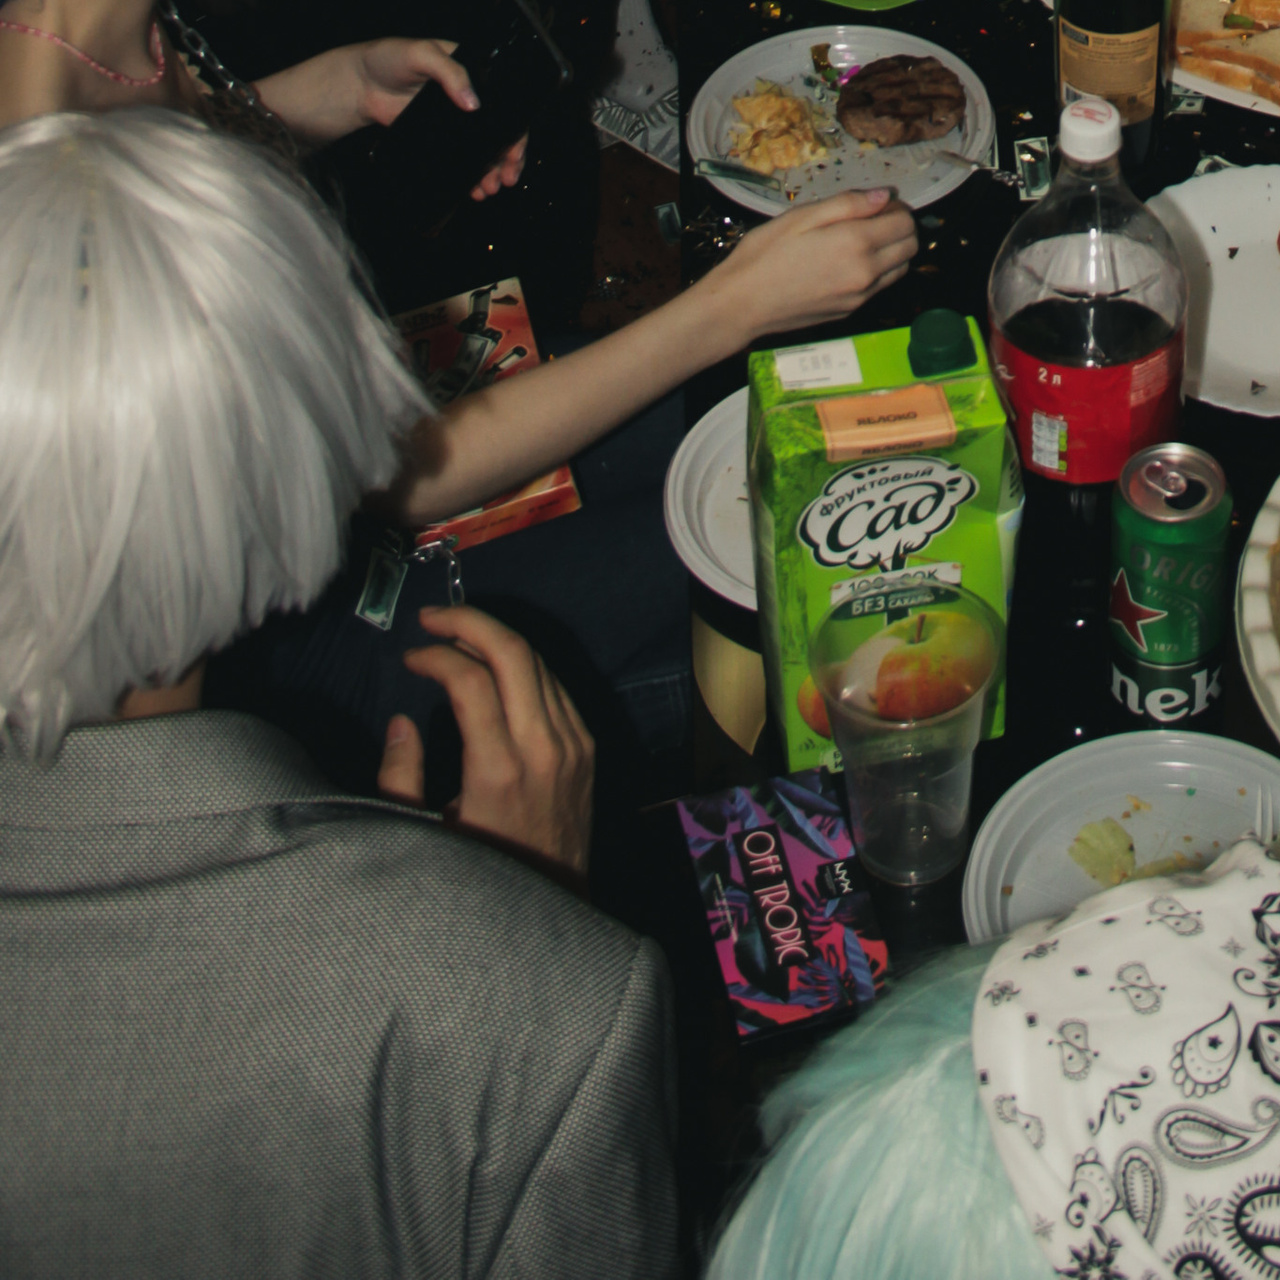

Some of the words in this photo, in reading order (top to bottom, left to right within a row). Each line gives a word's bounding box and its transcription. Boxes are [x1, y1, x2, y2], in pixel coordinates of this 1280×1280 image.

[1037, 366, 1049, 384] 2
[856, 411, 918, 426] ЯБЛОКО
[861, 441, 925, 456] ЯБЛОКО
[826, 481, 946, 553] Сад
[833, 861, 854, 895] NYX
[753, 879, 810, 967] TROPIC
